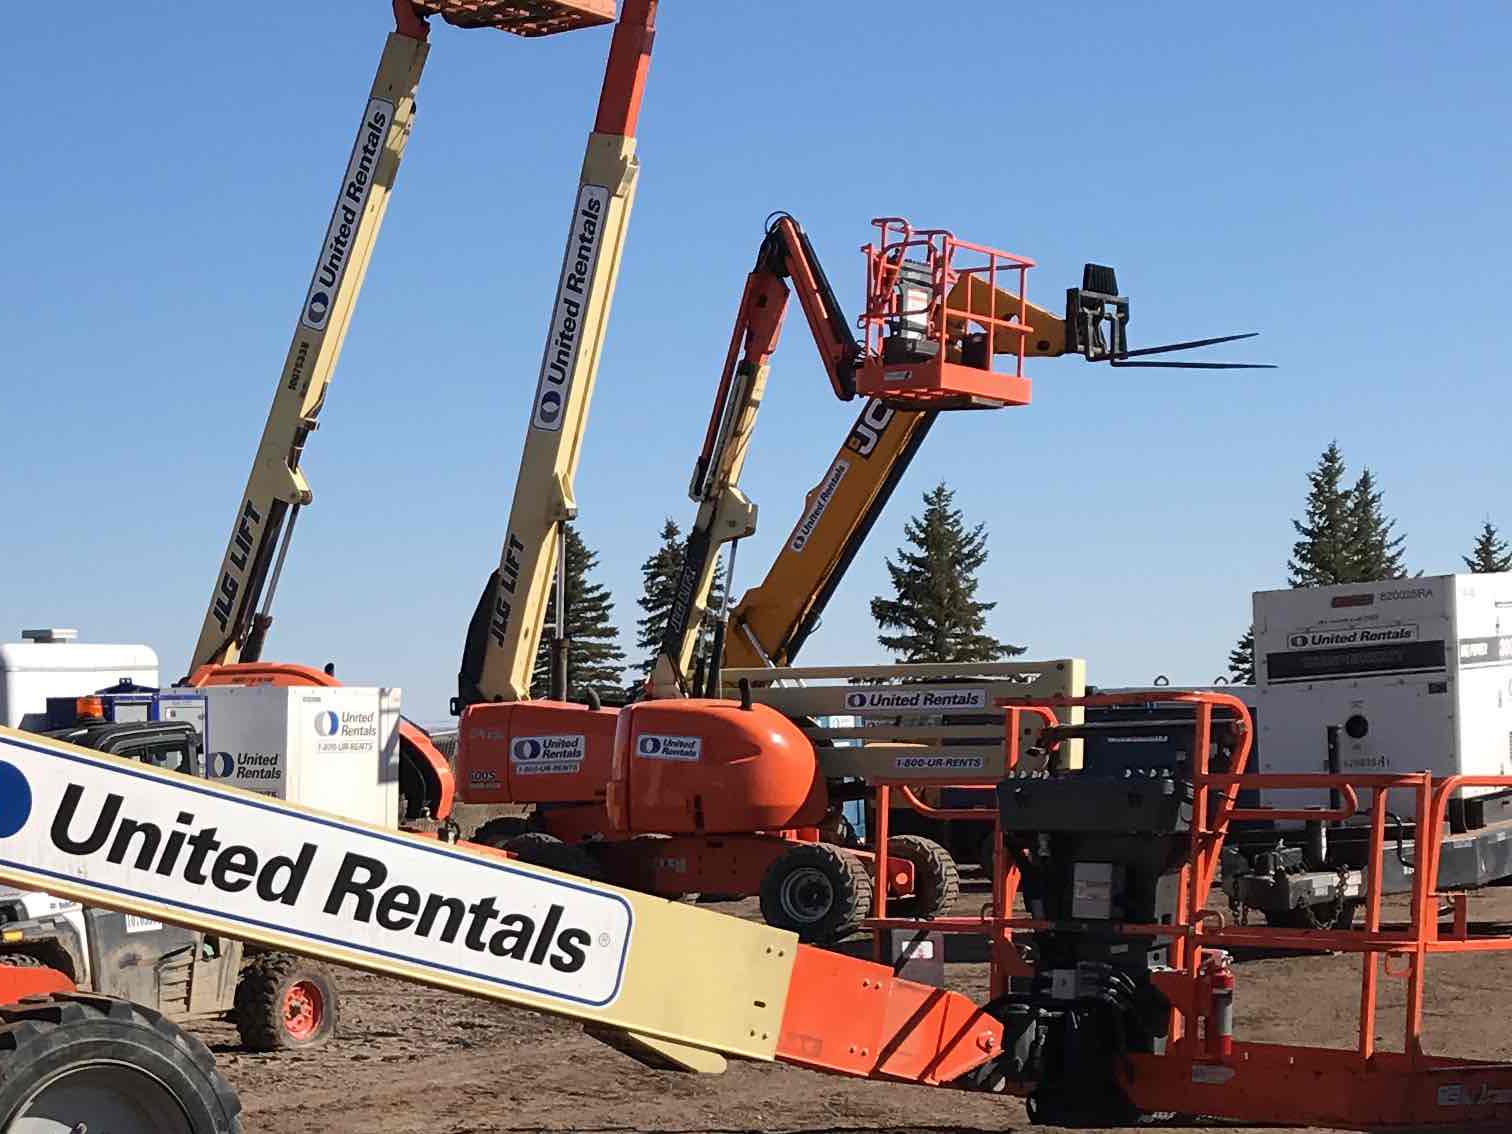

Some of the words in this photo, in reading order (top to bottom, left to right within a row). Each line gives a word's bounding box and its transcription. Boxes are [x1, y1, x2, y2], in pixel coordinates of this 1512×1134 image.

[318, 207, 356, 289] United
[345, 110, 387, 204] Rentals
[548, 298, 581, 386] United
[566, 197, 602, 295] Rentals
[856, 397, 895, 456] JC
[800, 494, 826, 537] United
[820, 462, 846, 505] Rentals
[212, 571, 239, 633] JLG
[229, 499, 261, 573] LIFT
[491, 596, 511, 649] JLG
[501, 532, 524, 595] LIFT
[1311, 632, 1357, 646] United
[1359, 627, 1412, 642] Rentals
[868, 692, 920, 707] United
[922, 691, 979, 706] Rentals
[341, 711, 375, 723] United
[341, 725, 377, 737] Rentals
[542, 737, 579, 750] United
[236, 752, 279, 767] United
[541, 749, 582, 761] Rentals
[236, 766, 282, 780] Rentals
[48, 783, 319, 907] United
[322, 850, 593, 973] Rentals
